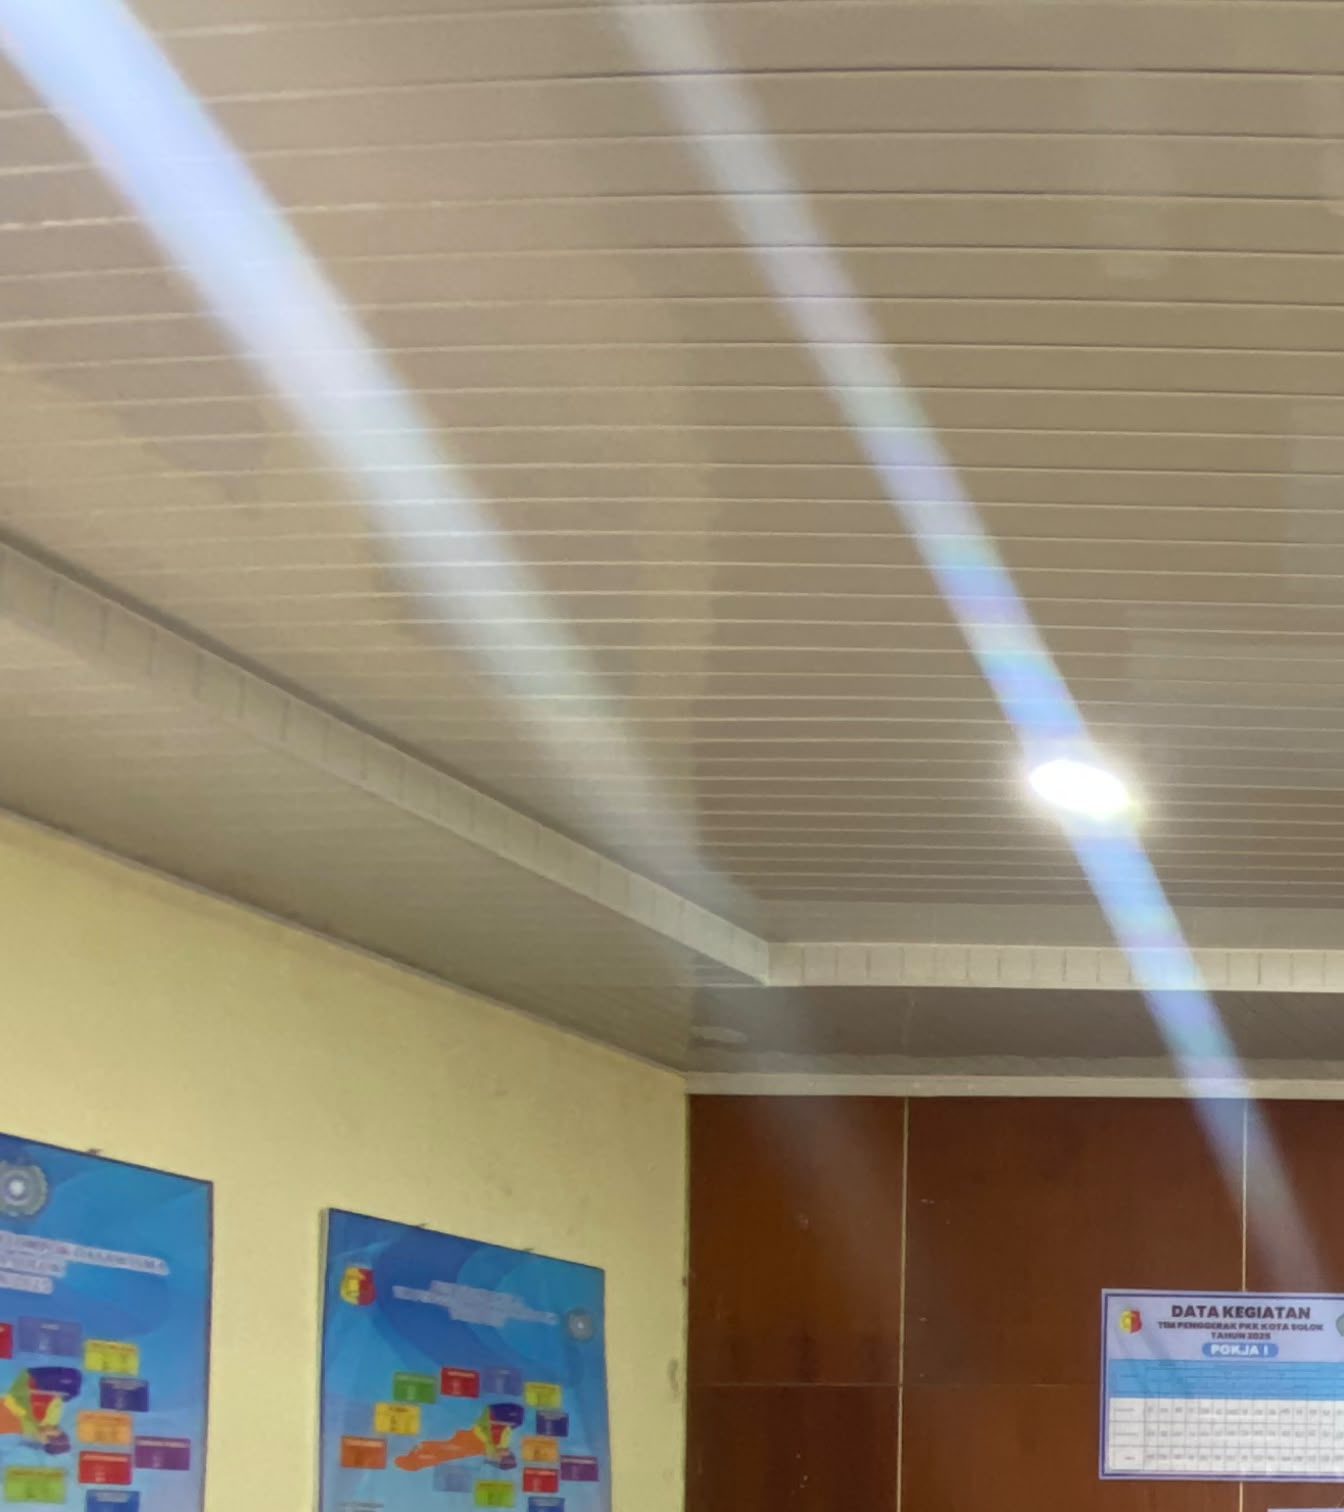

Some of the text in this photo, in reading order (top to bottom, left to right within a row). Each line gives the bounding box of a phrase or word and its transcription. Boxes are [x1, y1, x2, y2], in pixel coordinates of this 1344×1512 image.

[1172, 1305, 1310, 1319] DATA KEGIATAN
[1158, 1321, 1176, 1329] TIM
[1177, 1322, 1236, 1330] PENGGERAK
[1211, 1344, 1268, 1355] POKJA I
